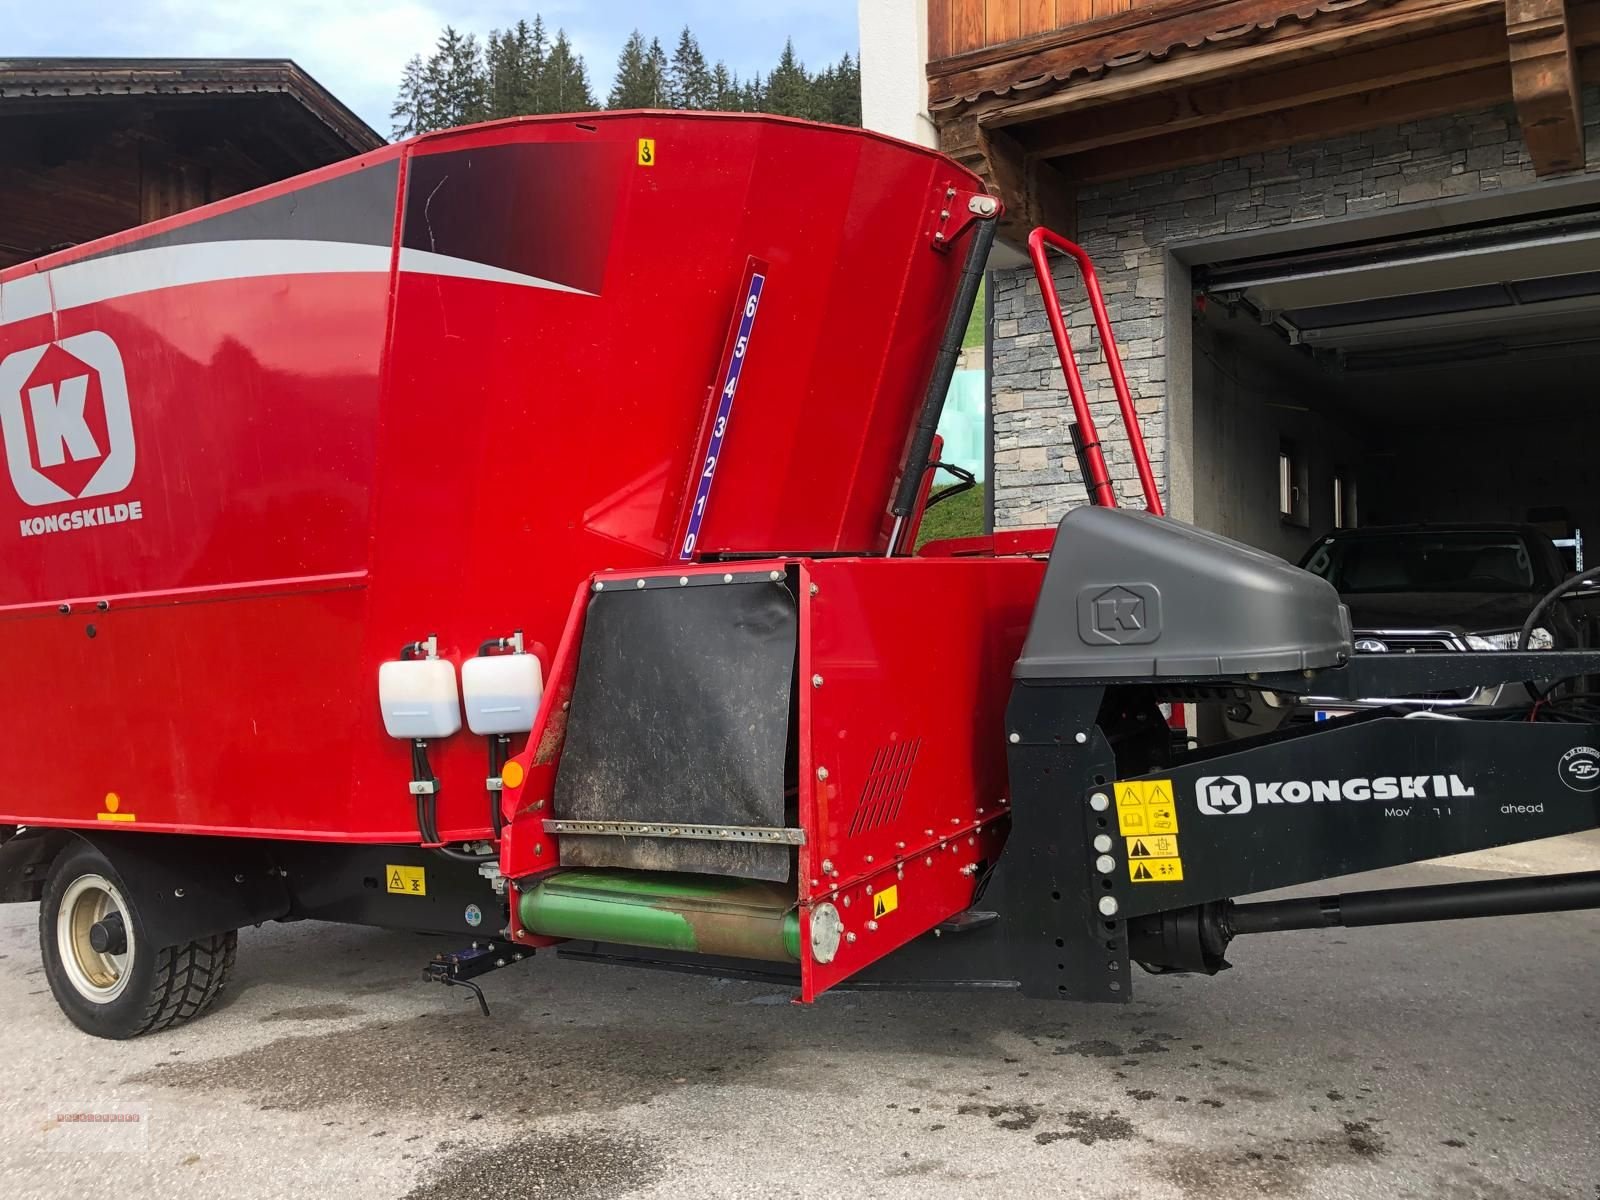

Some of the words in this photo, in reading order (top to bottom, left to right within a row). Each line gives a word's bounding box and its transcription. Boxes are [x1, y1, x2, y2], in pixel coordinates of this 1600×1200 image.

[745, 295, 757, 318] 6
[735, 336, 747, 358] 5
[724, 377, 736, 399] 4
[28, 374, 102, 468] K
[714, 416, 725, 438] 3
[703, 456, 716, 477] 2
[697, 496, 706, 516] 1
[20, 501, 143, 537] KONGSKILDE
[684, 533, 696, 553] 0
[1500, 802, 1544, 814] ahead
